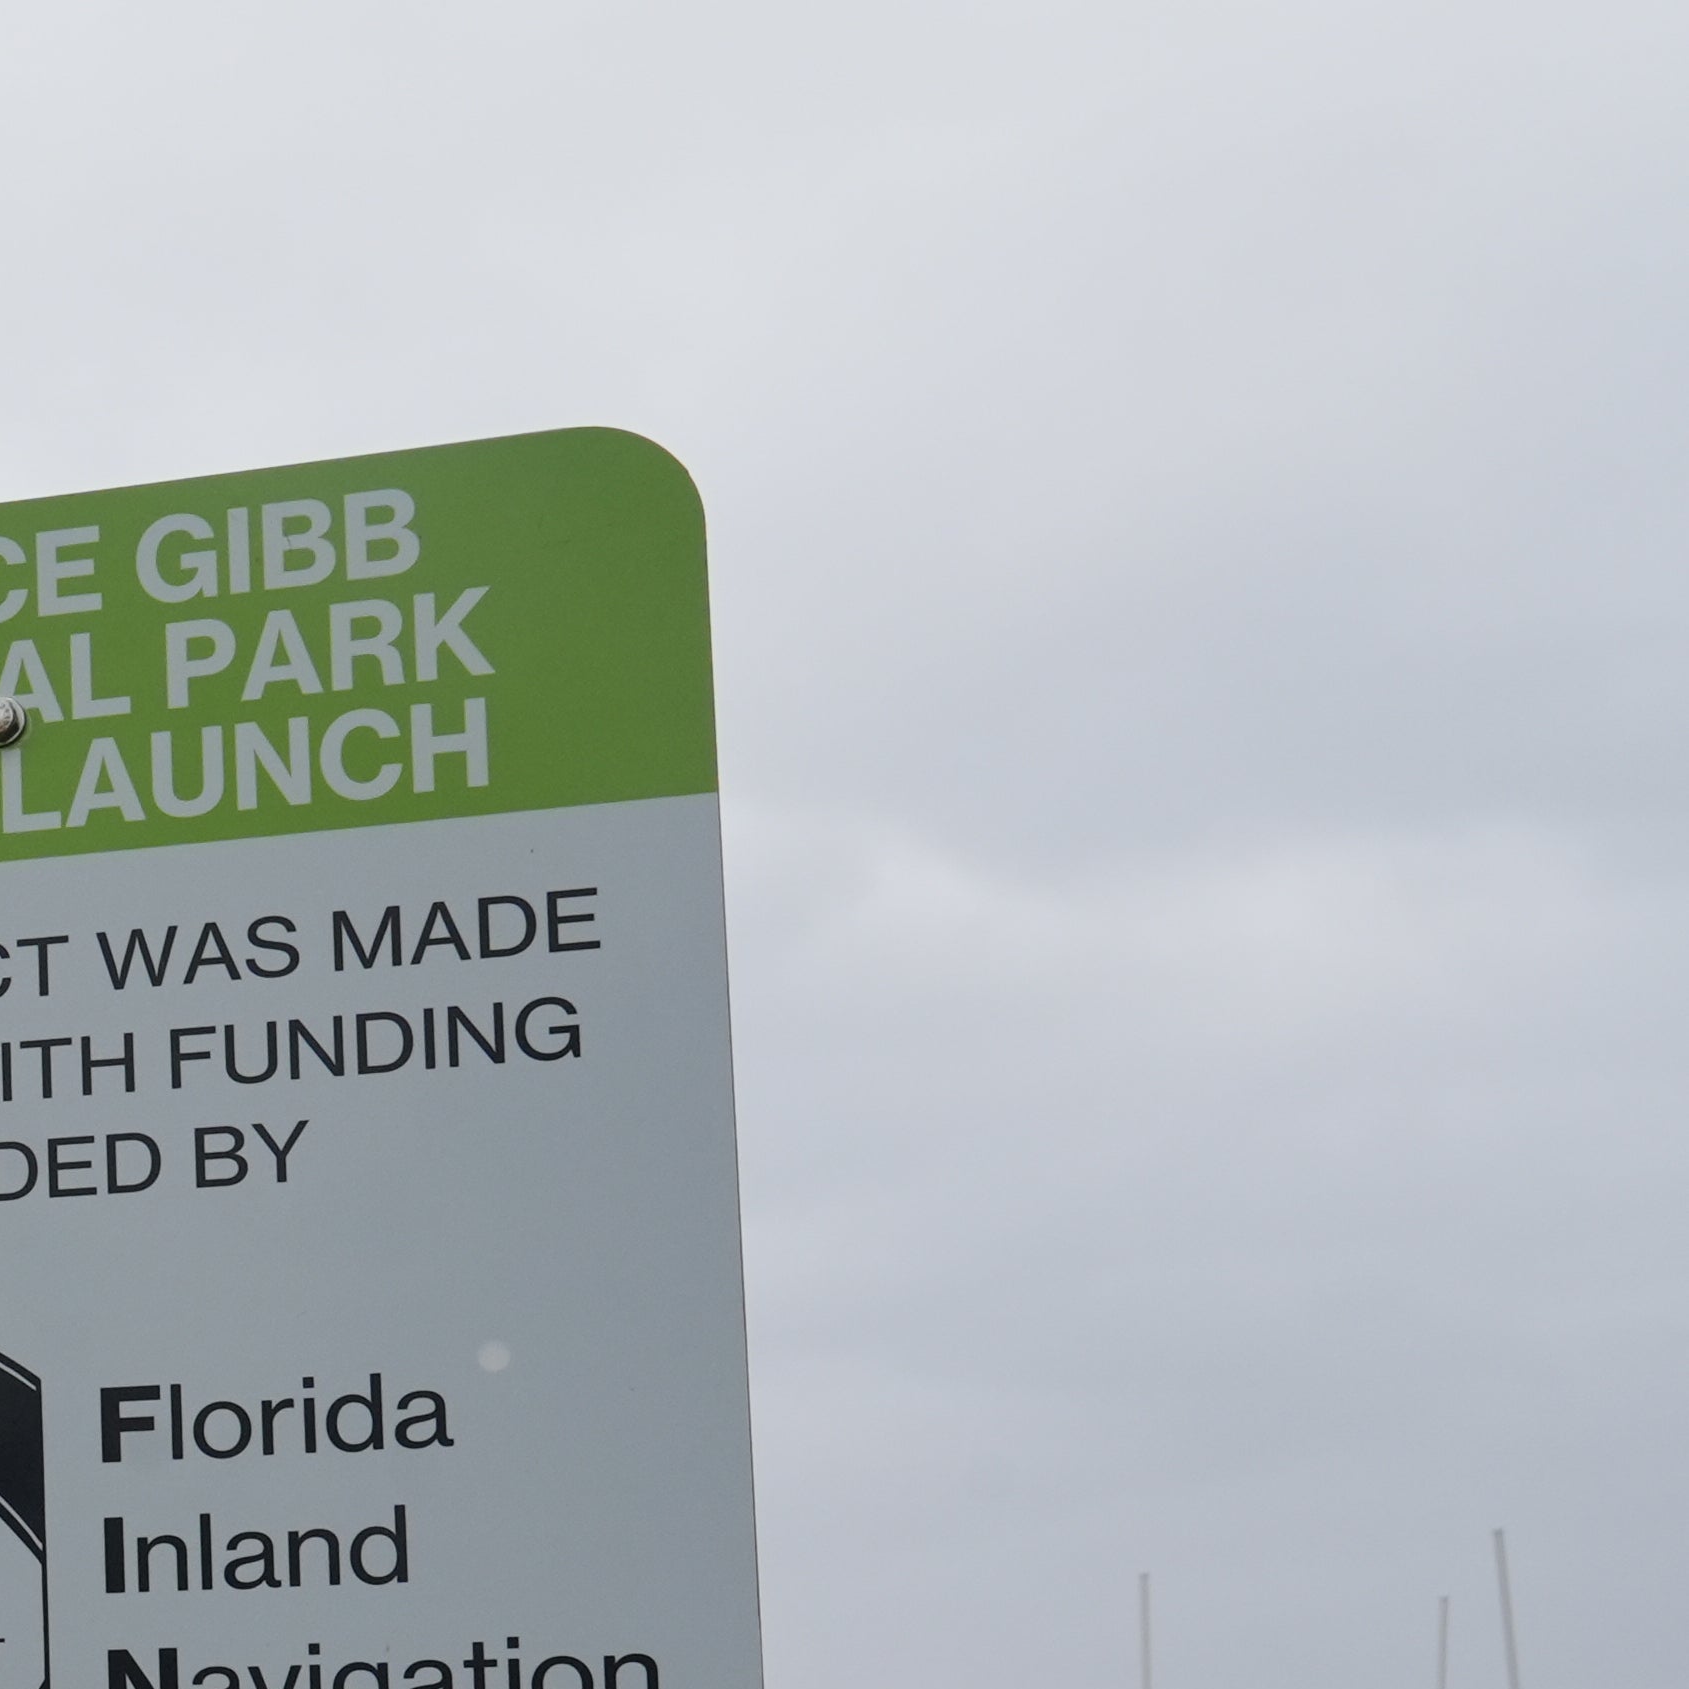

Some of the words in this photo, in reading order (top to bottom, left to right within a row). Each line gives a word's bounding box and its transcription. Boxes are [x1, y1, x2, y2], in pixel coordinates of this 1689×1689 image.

[134, 485, 422, 605] GIBB
[164, 584, 497, 710] PARK
[0, 695, 491, 835] LAUNCH
[94, 914, 301, 992] WAS
[331, 886, 602, 973] MADE
[168, 995, 582, 1091] FUNDING
[193, 1118, 310, 1190] BY
[98, 1371, 456, 1465] Florida
[102, 1503, 410, 1595] Inland
